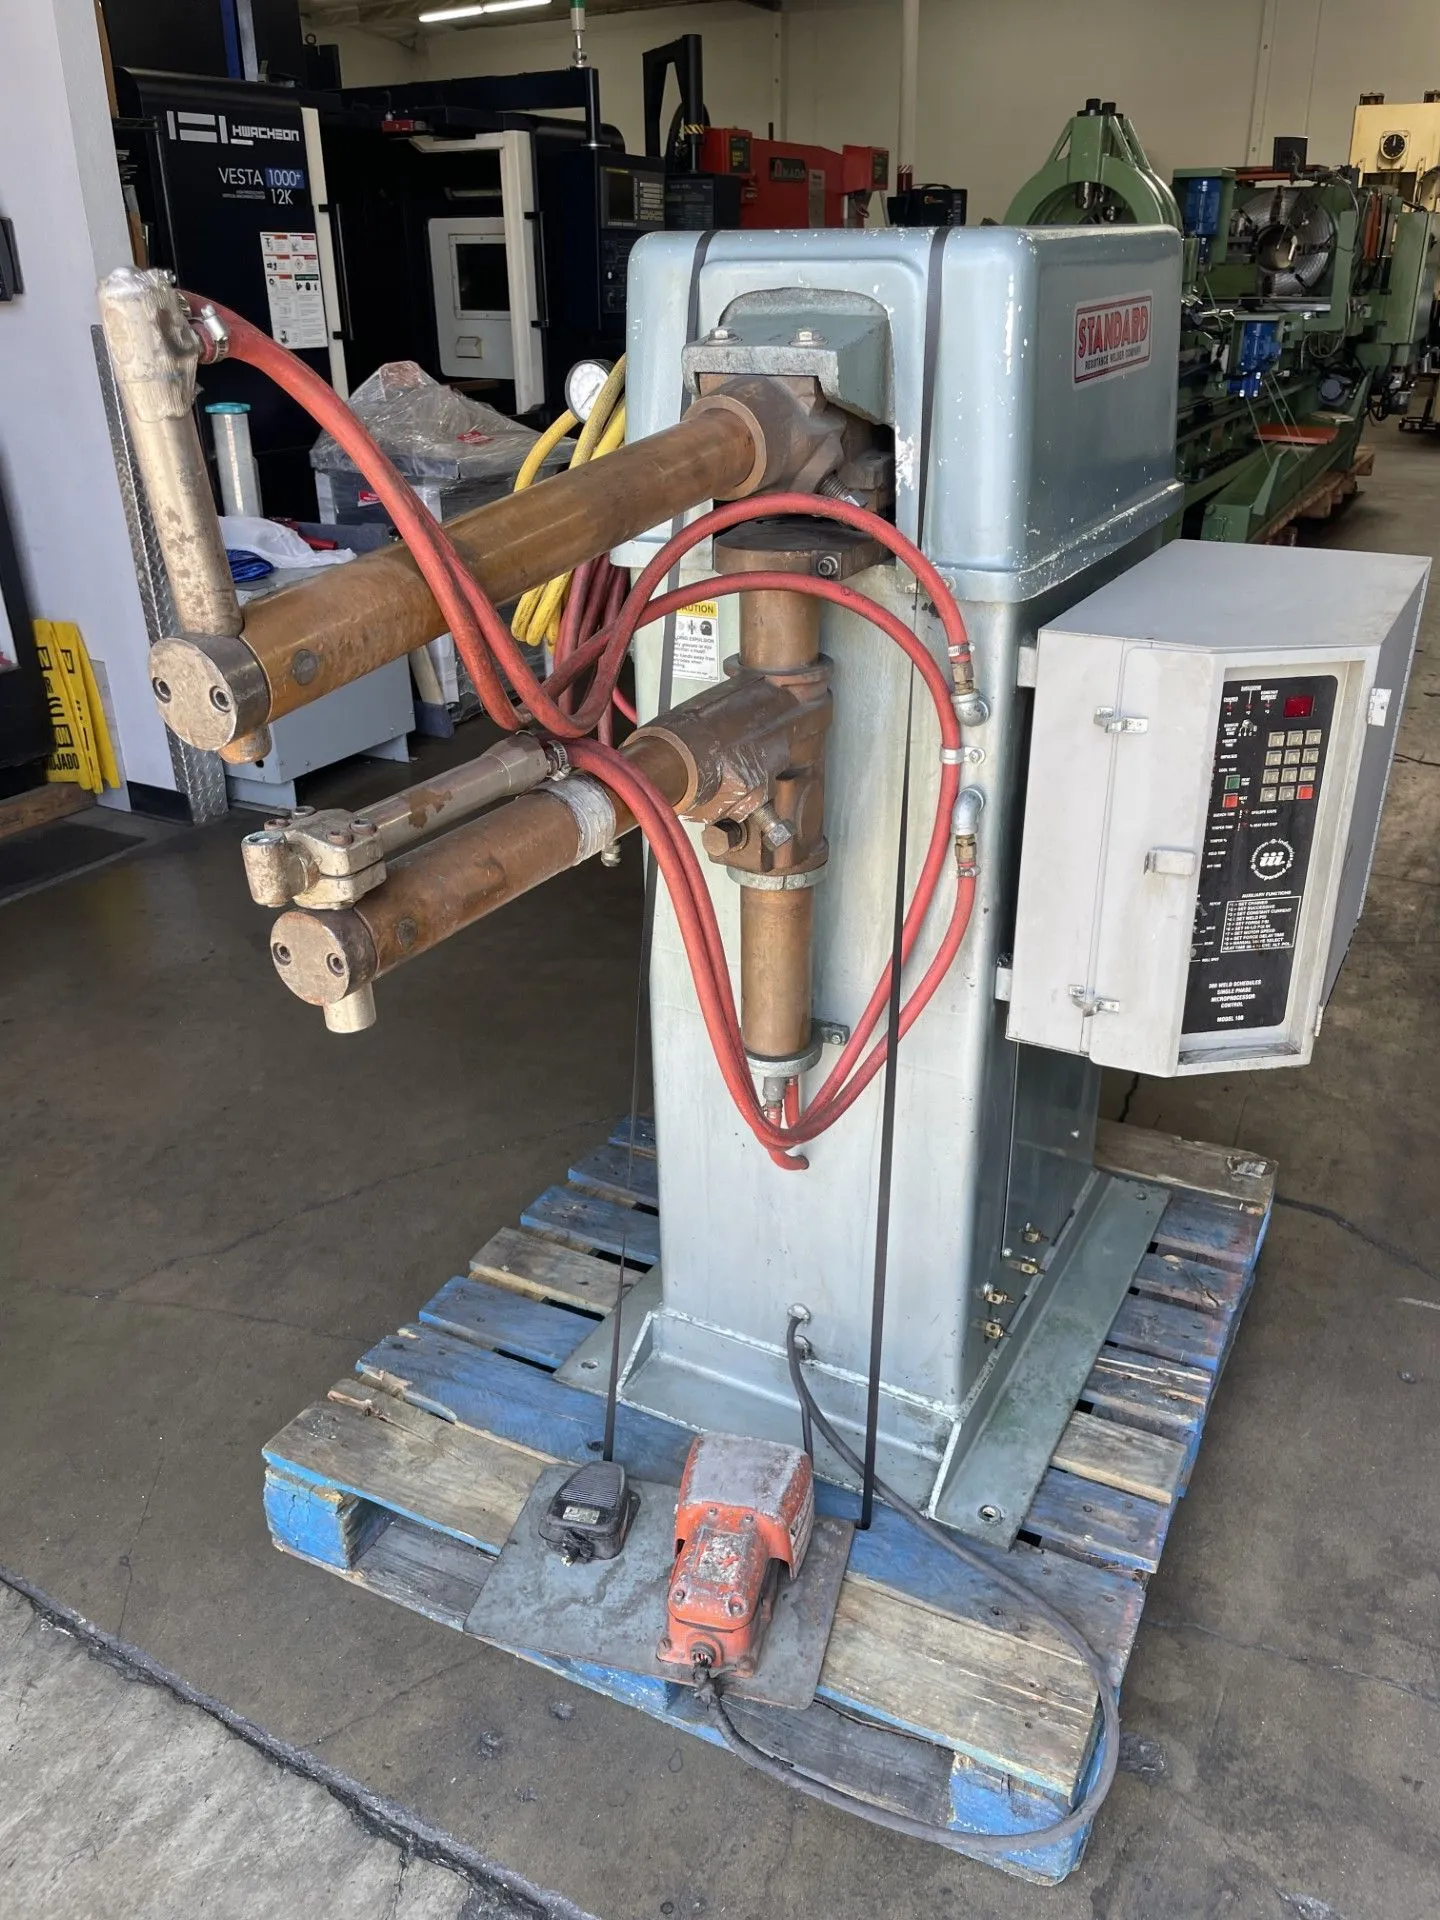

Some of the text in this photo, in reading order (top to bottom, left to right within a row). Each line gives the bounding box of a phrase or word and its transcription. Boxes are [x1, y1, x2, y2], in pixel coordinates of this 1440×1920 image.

[232, 125, 300, 142] HWACHEON
[218, 167, 264, 186] VESTA
[271, 188, 294, 205] 12K
[1078, 305, 1149, 358] STANDARD
[679, 604, 714, 614] AUTION
